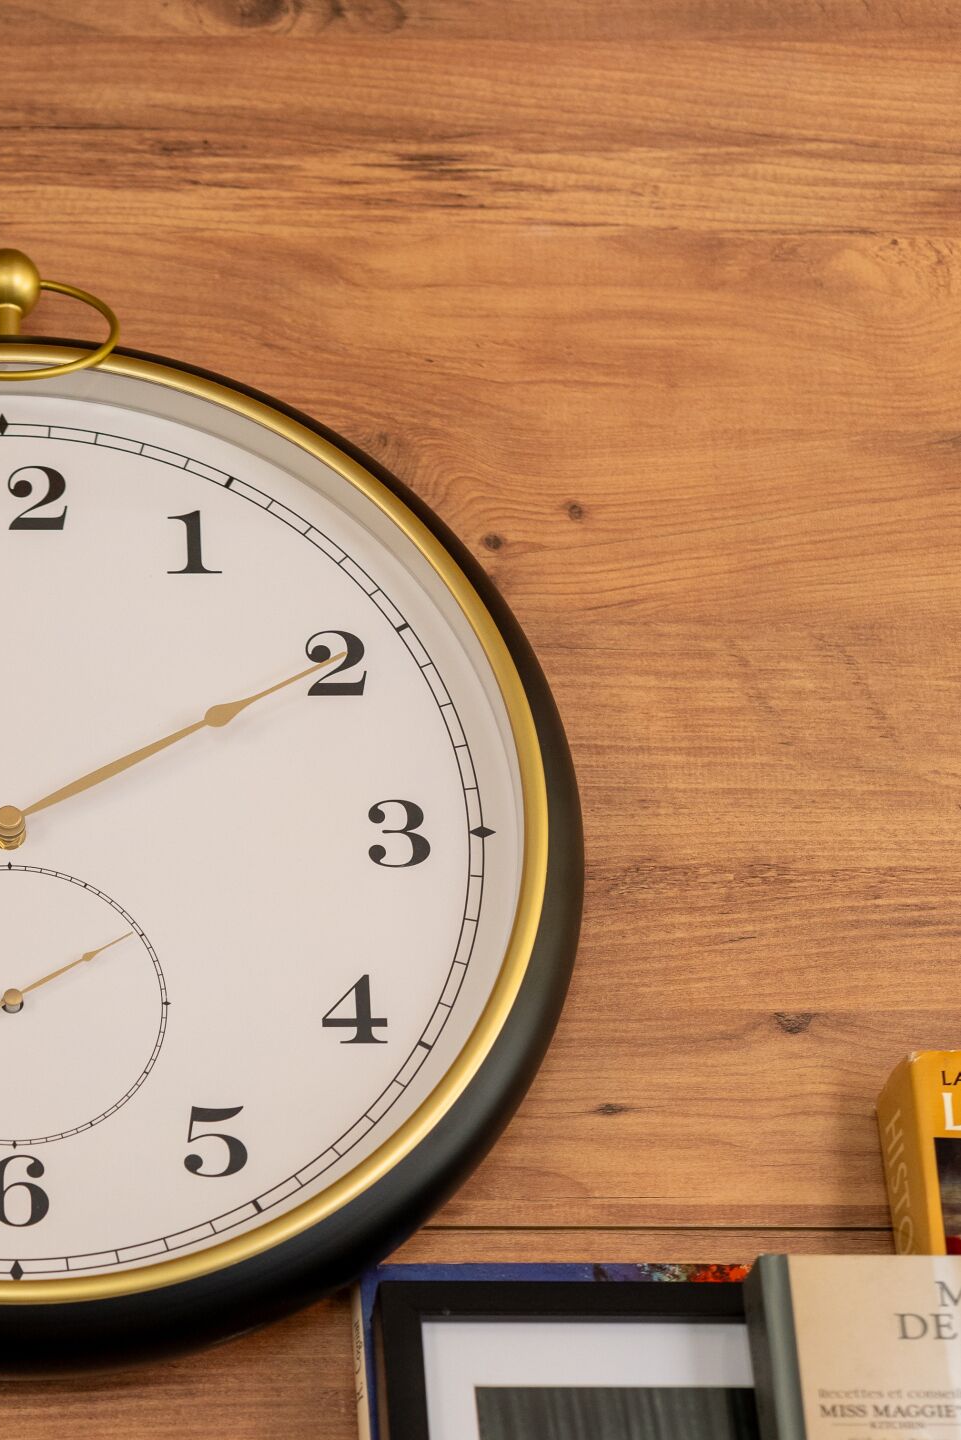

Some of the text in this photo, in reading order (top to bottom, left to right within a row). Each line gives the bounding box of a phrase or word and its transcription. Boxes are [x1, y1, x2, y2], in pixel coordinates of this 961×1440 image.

[167, 510, 223, 574] 1
[305, 630, 368, 697] 2
[368, 799, 431, 868] 3
[321, 974, 389, 1044] 4
[183, 1105, 248, 1178] 5
[884, 1108, 918, 1256] HISTO
[819, 1404, 868, 1418] MISS
